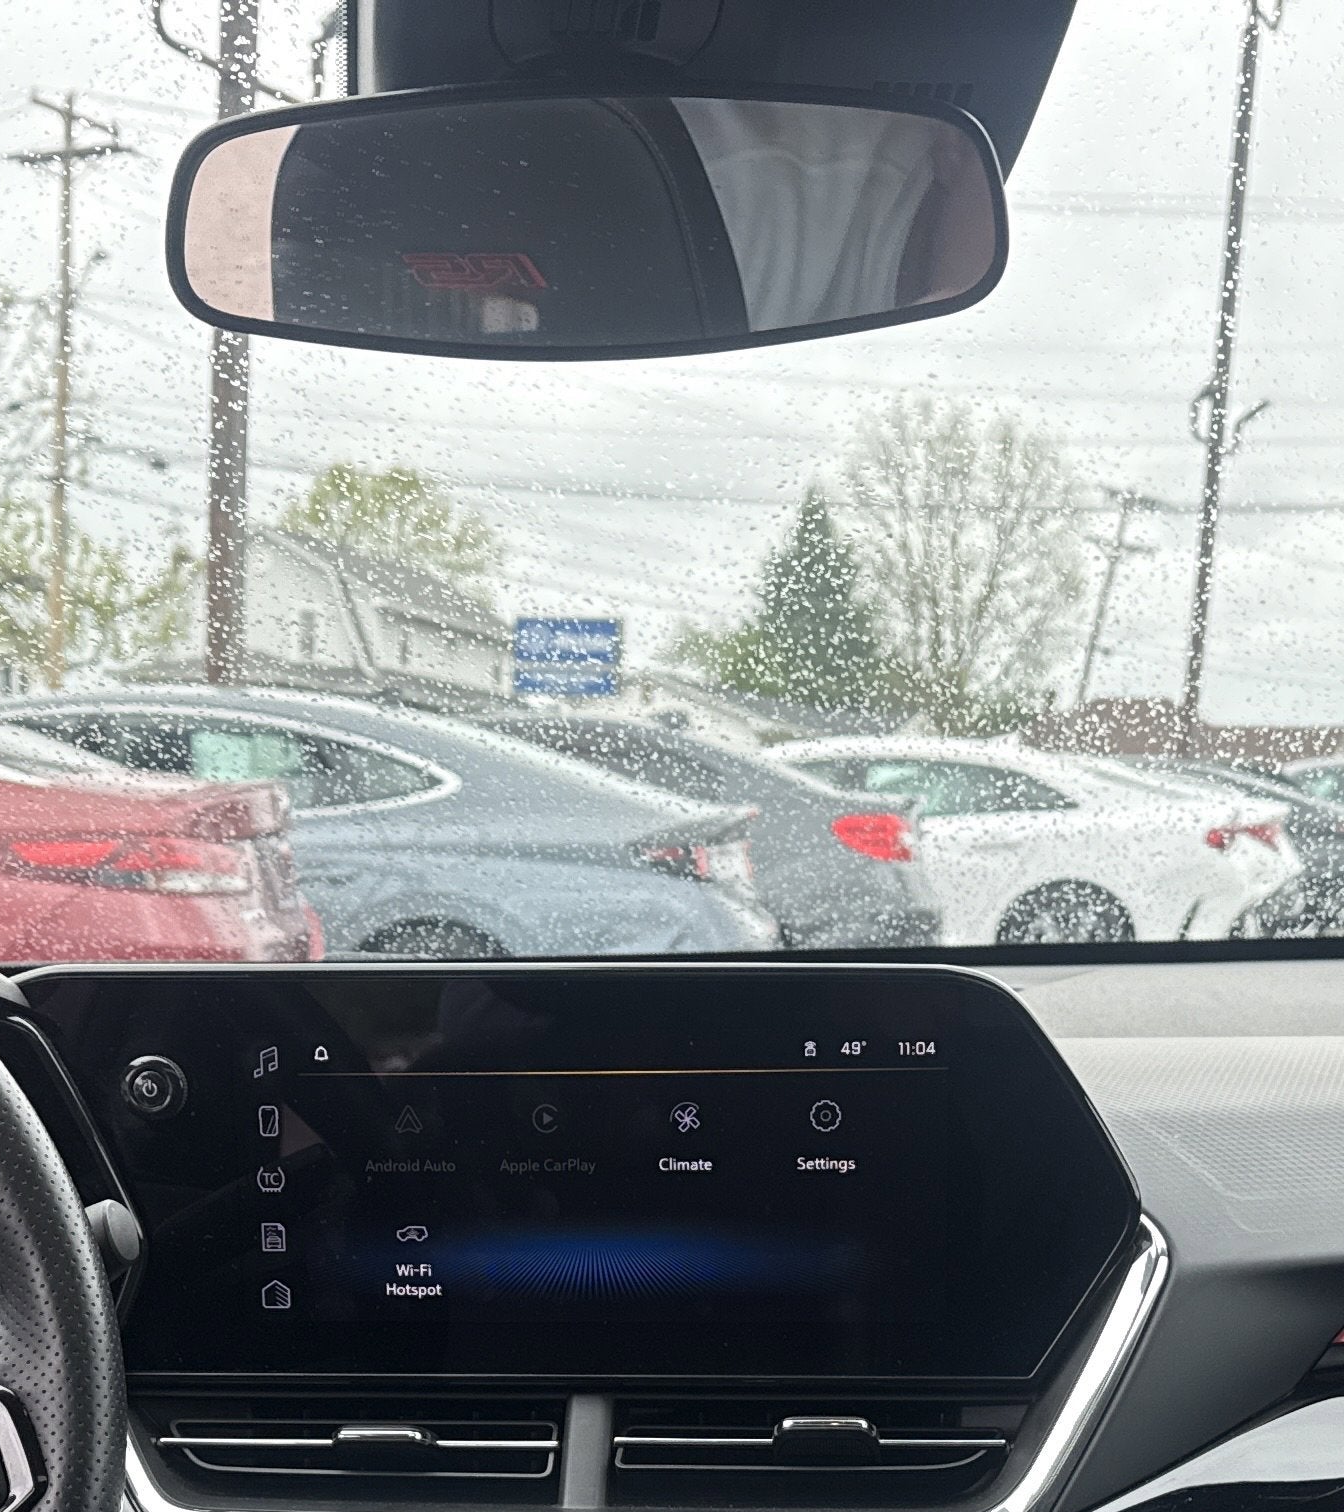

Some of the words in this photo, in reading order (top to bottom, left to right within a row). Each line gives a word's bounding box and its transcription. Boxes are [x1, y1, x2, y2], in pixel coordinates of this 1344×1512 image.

[898, 1041, 936, 1056] 11:04
[365, 1158, 420, 1172] Android
[423, 1159, 456, 1172] Auto
[500, 1158, 540, 1174] Apple
[543, 1158, 597, 1174] CarPlay
[658, 1157, 713, 1171] Climate
[796, 1156, 856, 1173] Settings
[396, 1264, 432, 1277] Wi-Fi
[386, 1283, 443, 1299] Hotspot
